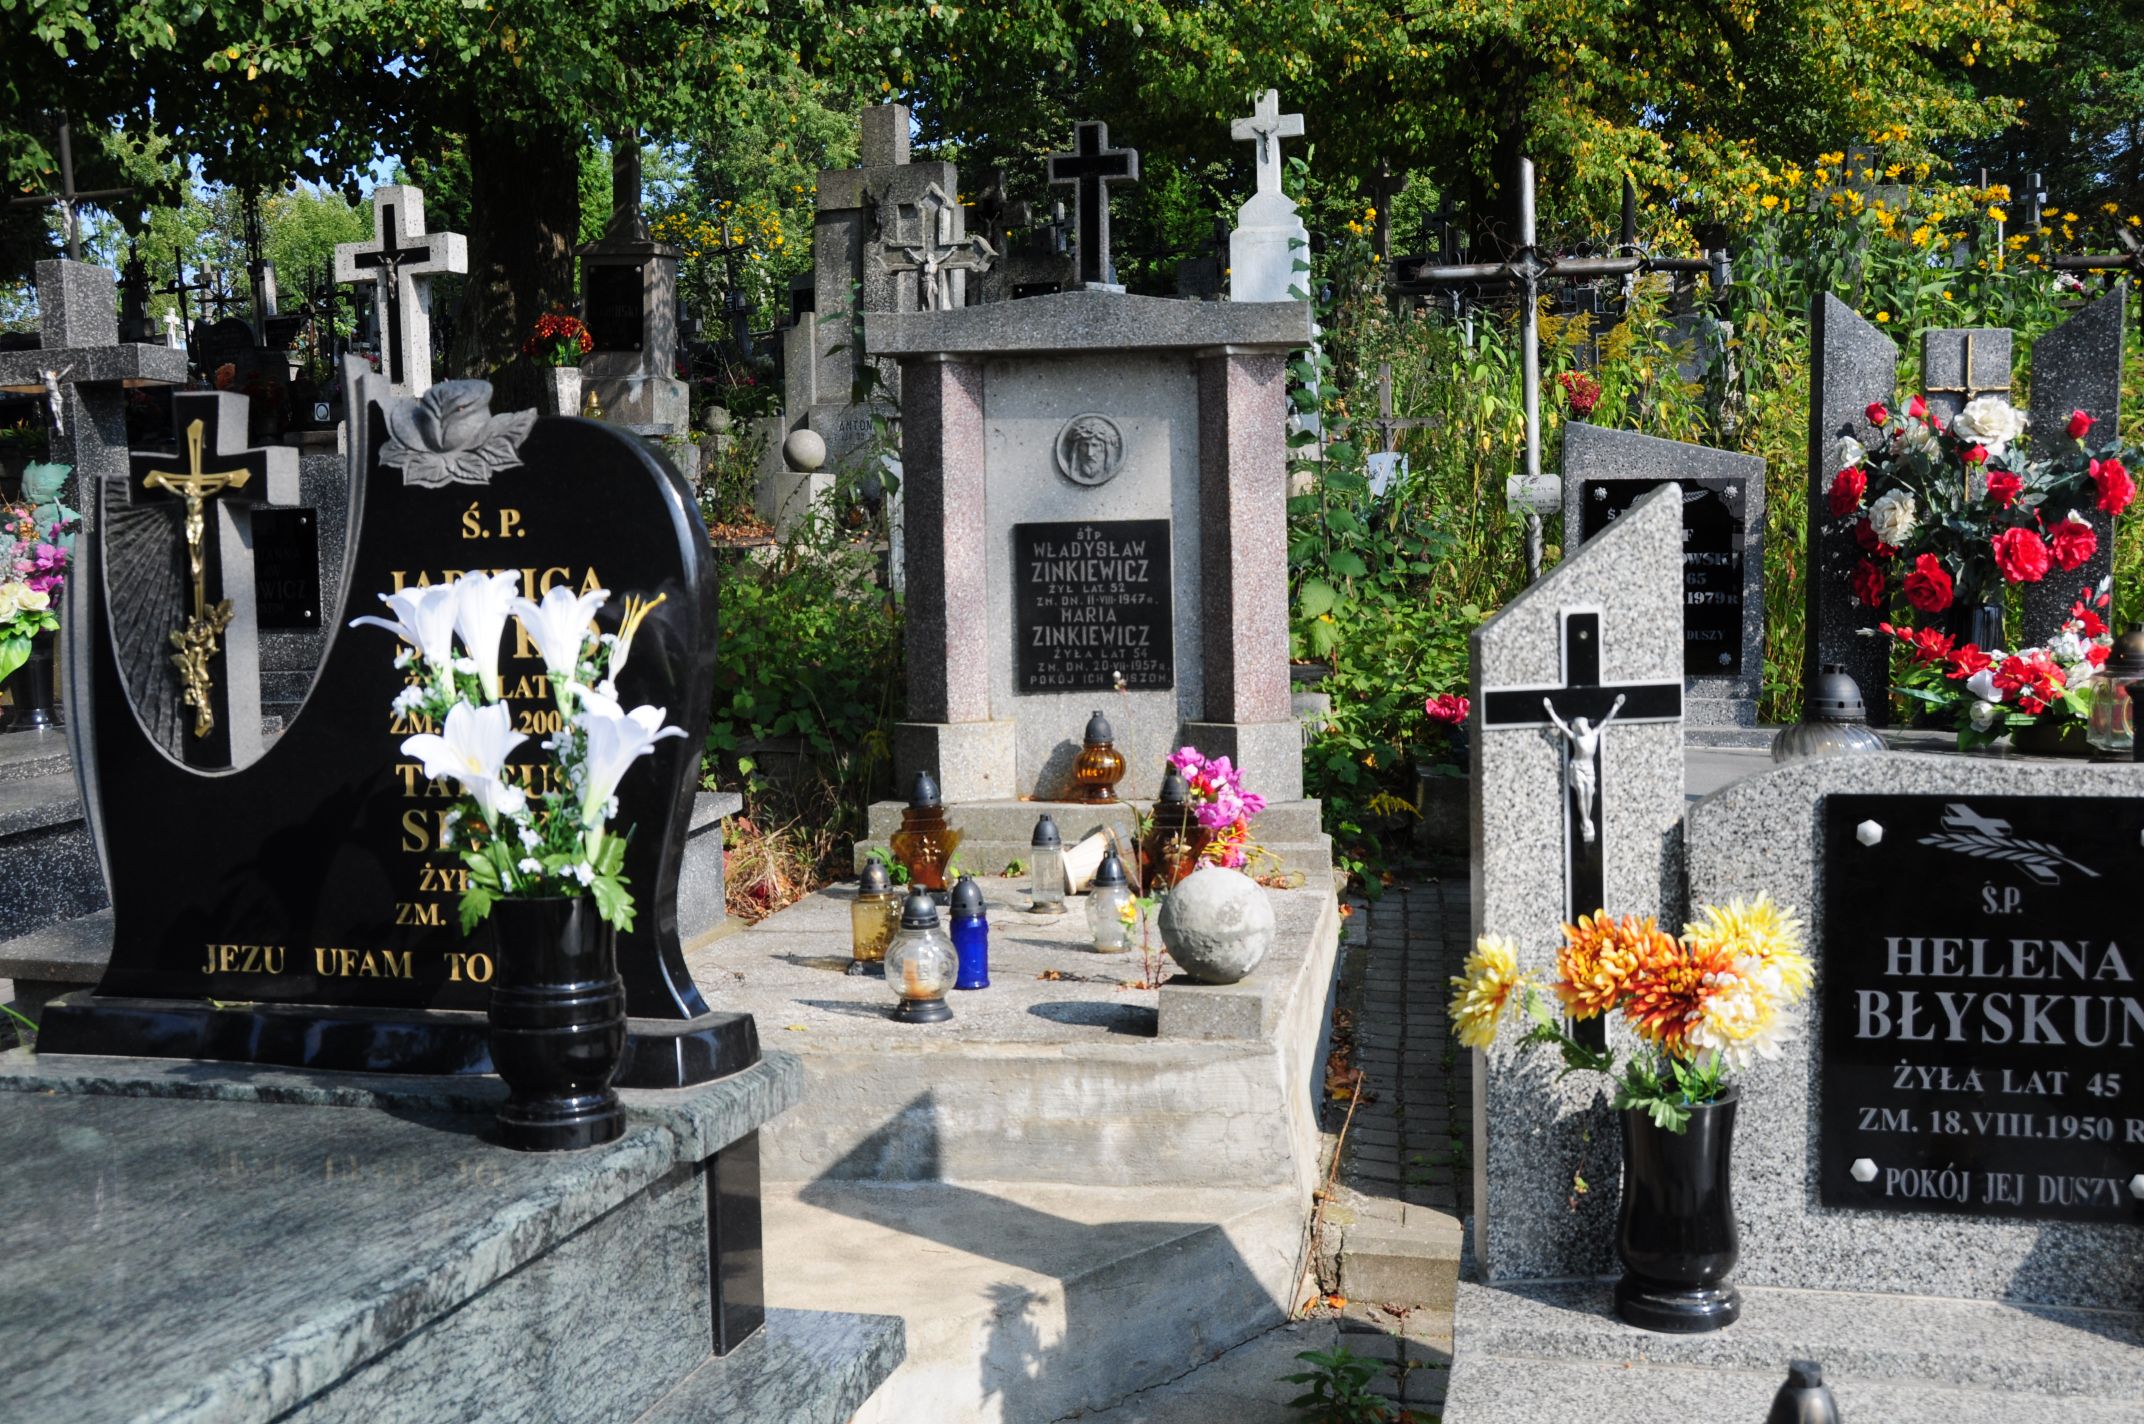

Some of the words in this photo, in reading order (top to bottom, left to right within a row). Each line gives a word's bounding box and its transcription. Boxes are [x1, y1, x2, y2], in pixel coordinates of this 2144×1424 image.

[1033, 540, 1147, 558] WŁADYSŁAW
[1031, 559, 1149, 583] ZINKIEWICZ
[1686, 572, 1706, 585] 65
[1110, 582, 1126, 593] 52
[1060, 606, 1117, 623] MARIA
[1032, 624, 1151, 647] ZINKIEWICZ
[1686, 630, 1725, 641] DUSZY
[1101, 649, 1126, 659] LAT
[1133, 648, 1148, 659] 54
[1030, 673, 1075, 685] POKÓJ
[1083, 673, 1104, 684] ICH
[395, 902, 447, 926] ZM.
[202, 943, 287, 975] JEZU
[314, 947, 414, 979] UFAM
[1884, 936, 2135, 982] HELENA
[1893, 1057, 1986, 1093] ŻYŁA
[2001, 1068, 2070, 1096] LAT
[2085, 1072, 2122, 1098] 45
[1857, 1106, 1919, 1134] ZM.
[1929, 1109, 2114, 1142] 18.VIII.1950
[1885, 1161, 1972, 1204] POKÓJ
[1982, 1171, 2026, 1206] JEJ
[2037, 1173, 2126, 1208] DUSZY
